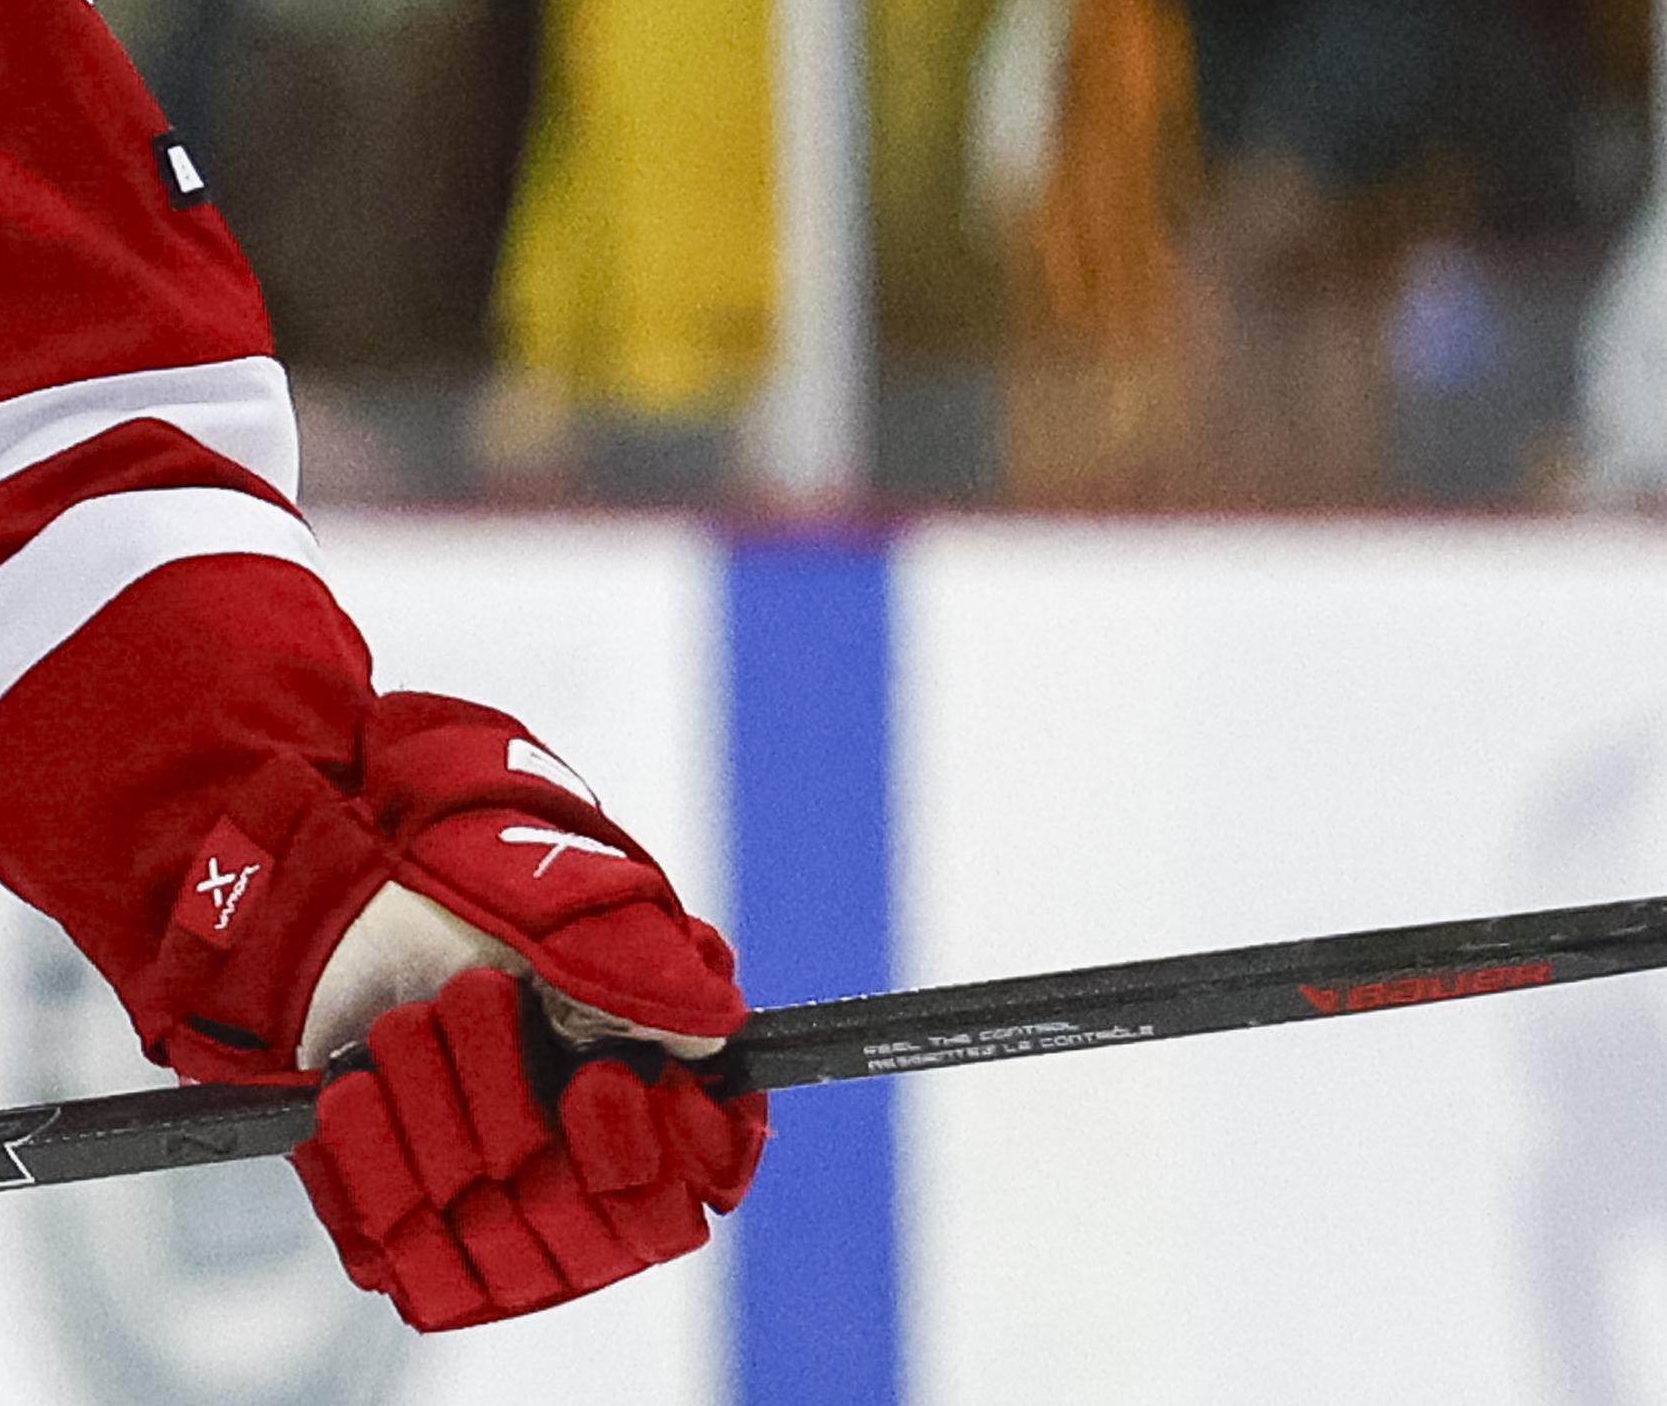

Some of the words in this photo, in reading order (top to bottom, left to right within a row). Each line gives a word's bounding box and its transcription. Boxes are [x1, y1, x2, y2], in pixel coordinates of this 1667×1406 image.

[863, 1042, 920, 1055] FEEL
[928, 1033, 971, 1047] THE
[978, 1021, 1079, 1042] CONTROL
